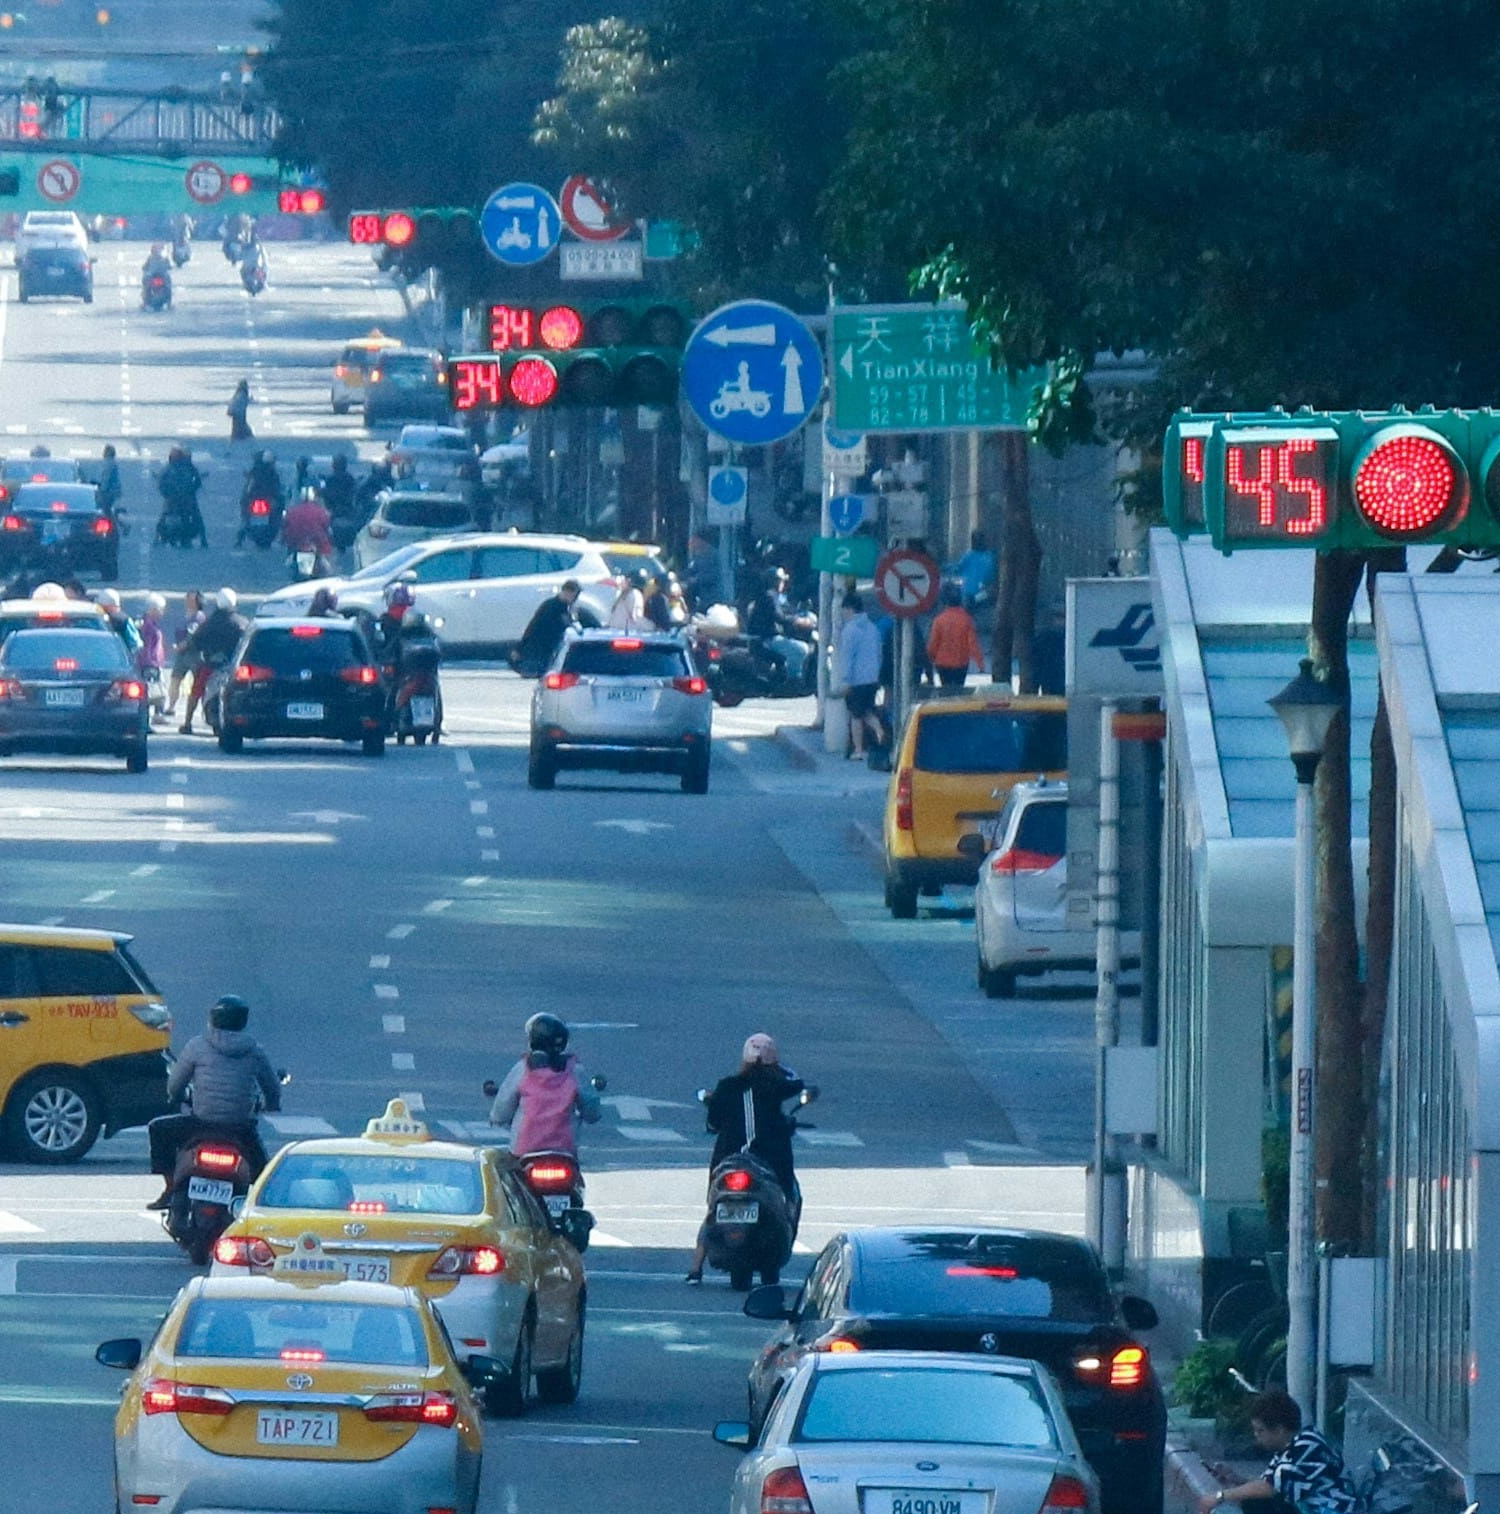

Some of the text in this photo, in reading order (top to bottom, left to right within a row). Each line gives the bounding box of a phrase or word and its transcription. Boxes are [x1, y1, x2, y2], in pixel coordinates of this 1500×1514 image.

[352, 215, 380, 243] 69
[491, 305, 532, 350] 34
[860, 359, 978, 380] TianXiang
[456, 362, 498, 409] 34
[1227, 437, 1327, 535] 45
[835, 546, 851, 566] 2
[261, 1417, 333, 1441] TAP-721
